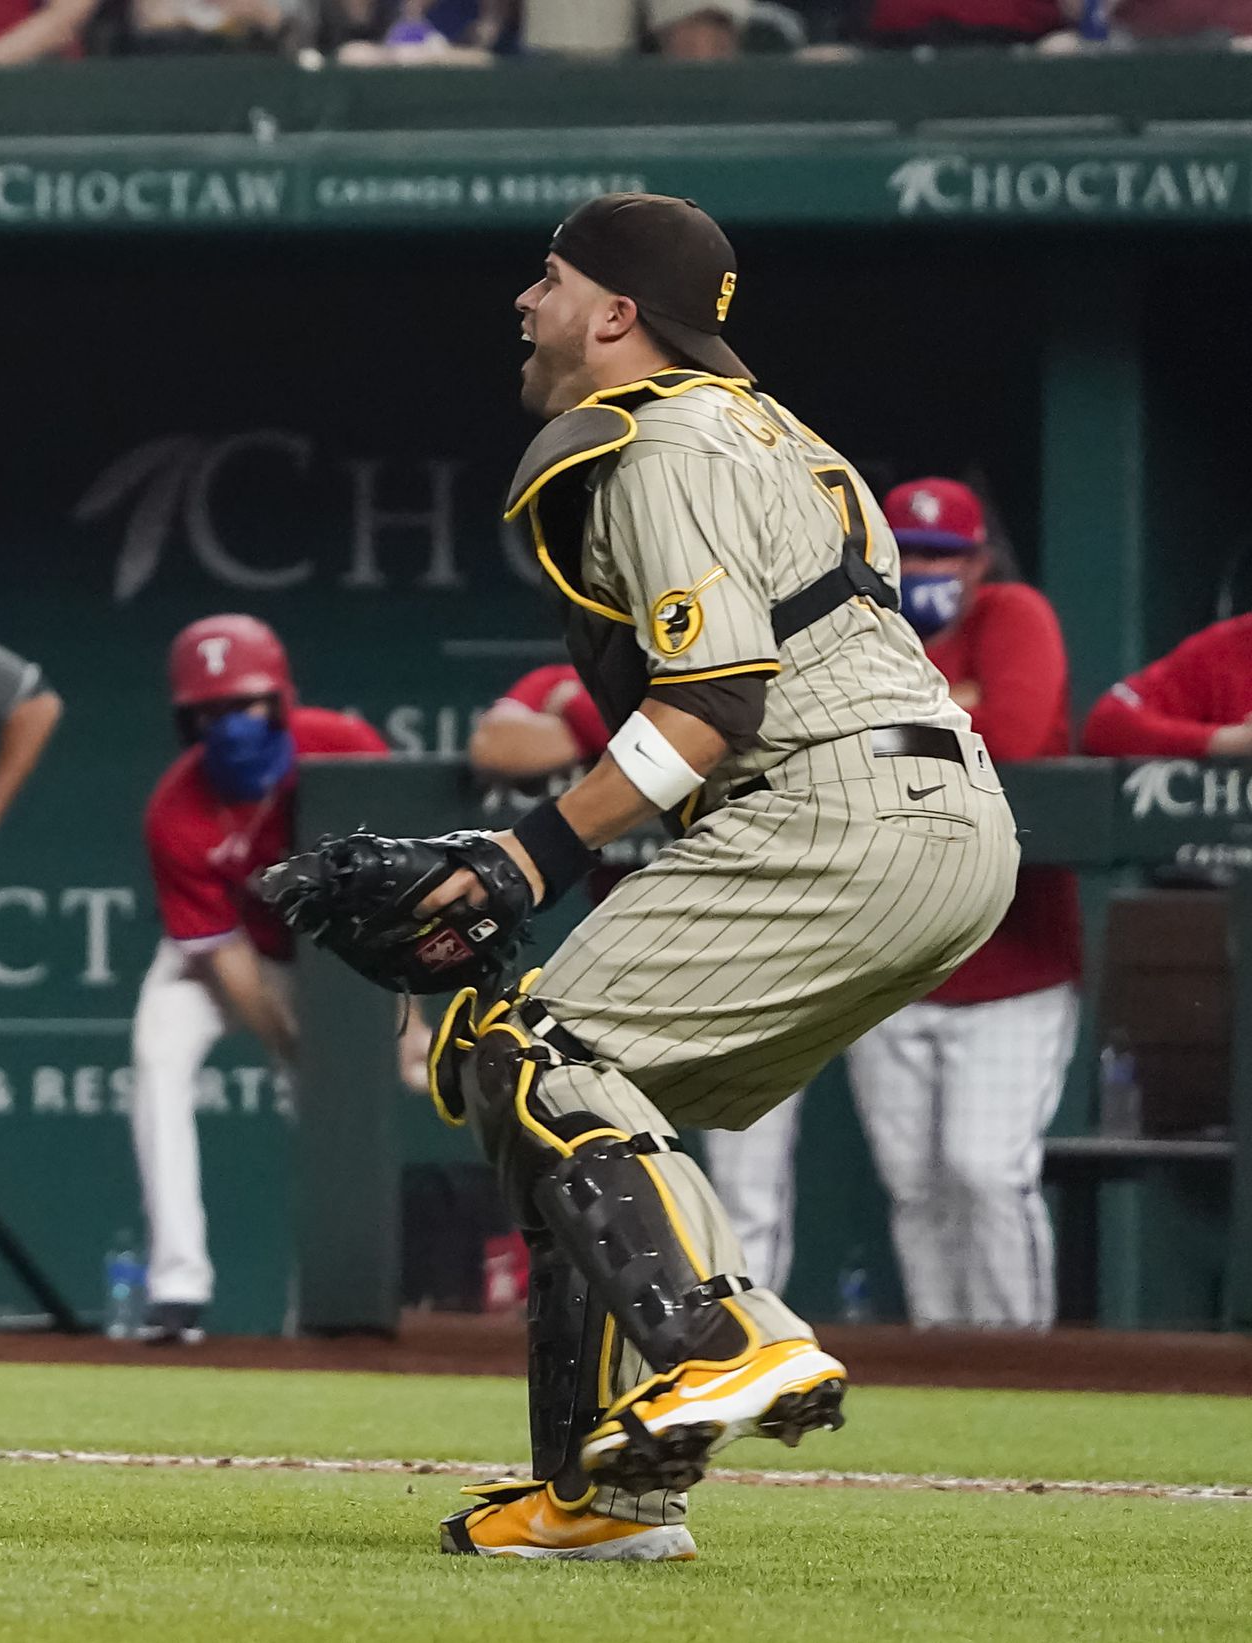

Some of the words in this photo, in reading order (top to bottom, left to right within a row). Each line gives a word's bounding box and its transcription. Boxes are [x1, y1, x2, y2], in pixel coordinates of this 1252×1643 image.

[0, 164, 284, 221] CHOCTAW
[928, 155, 1238, 213] CHOCTAW
[1156, 759, 1252, 816] CH
